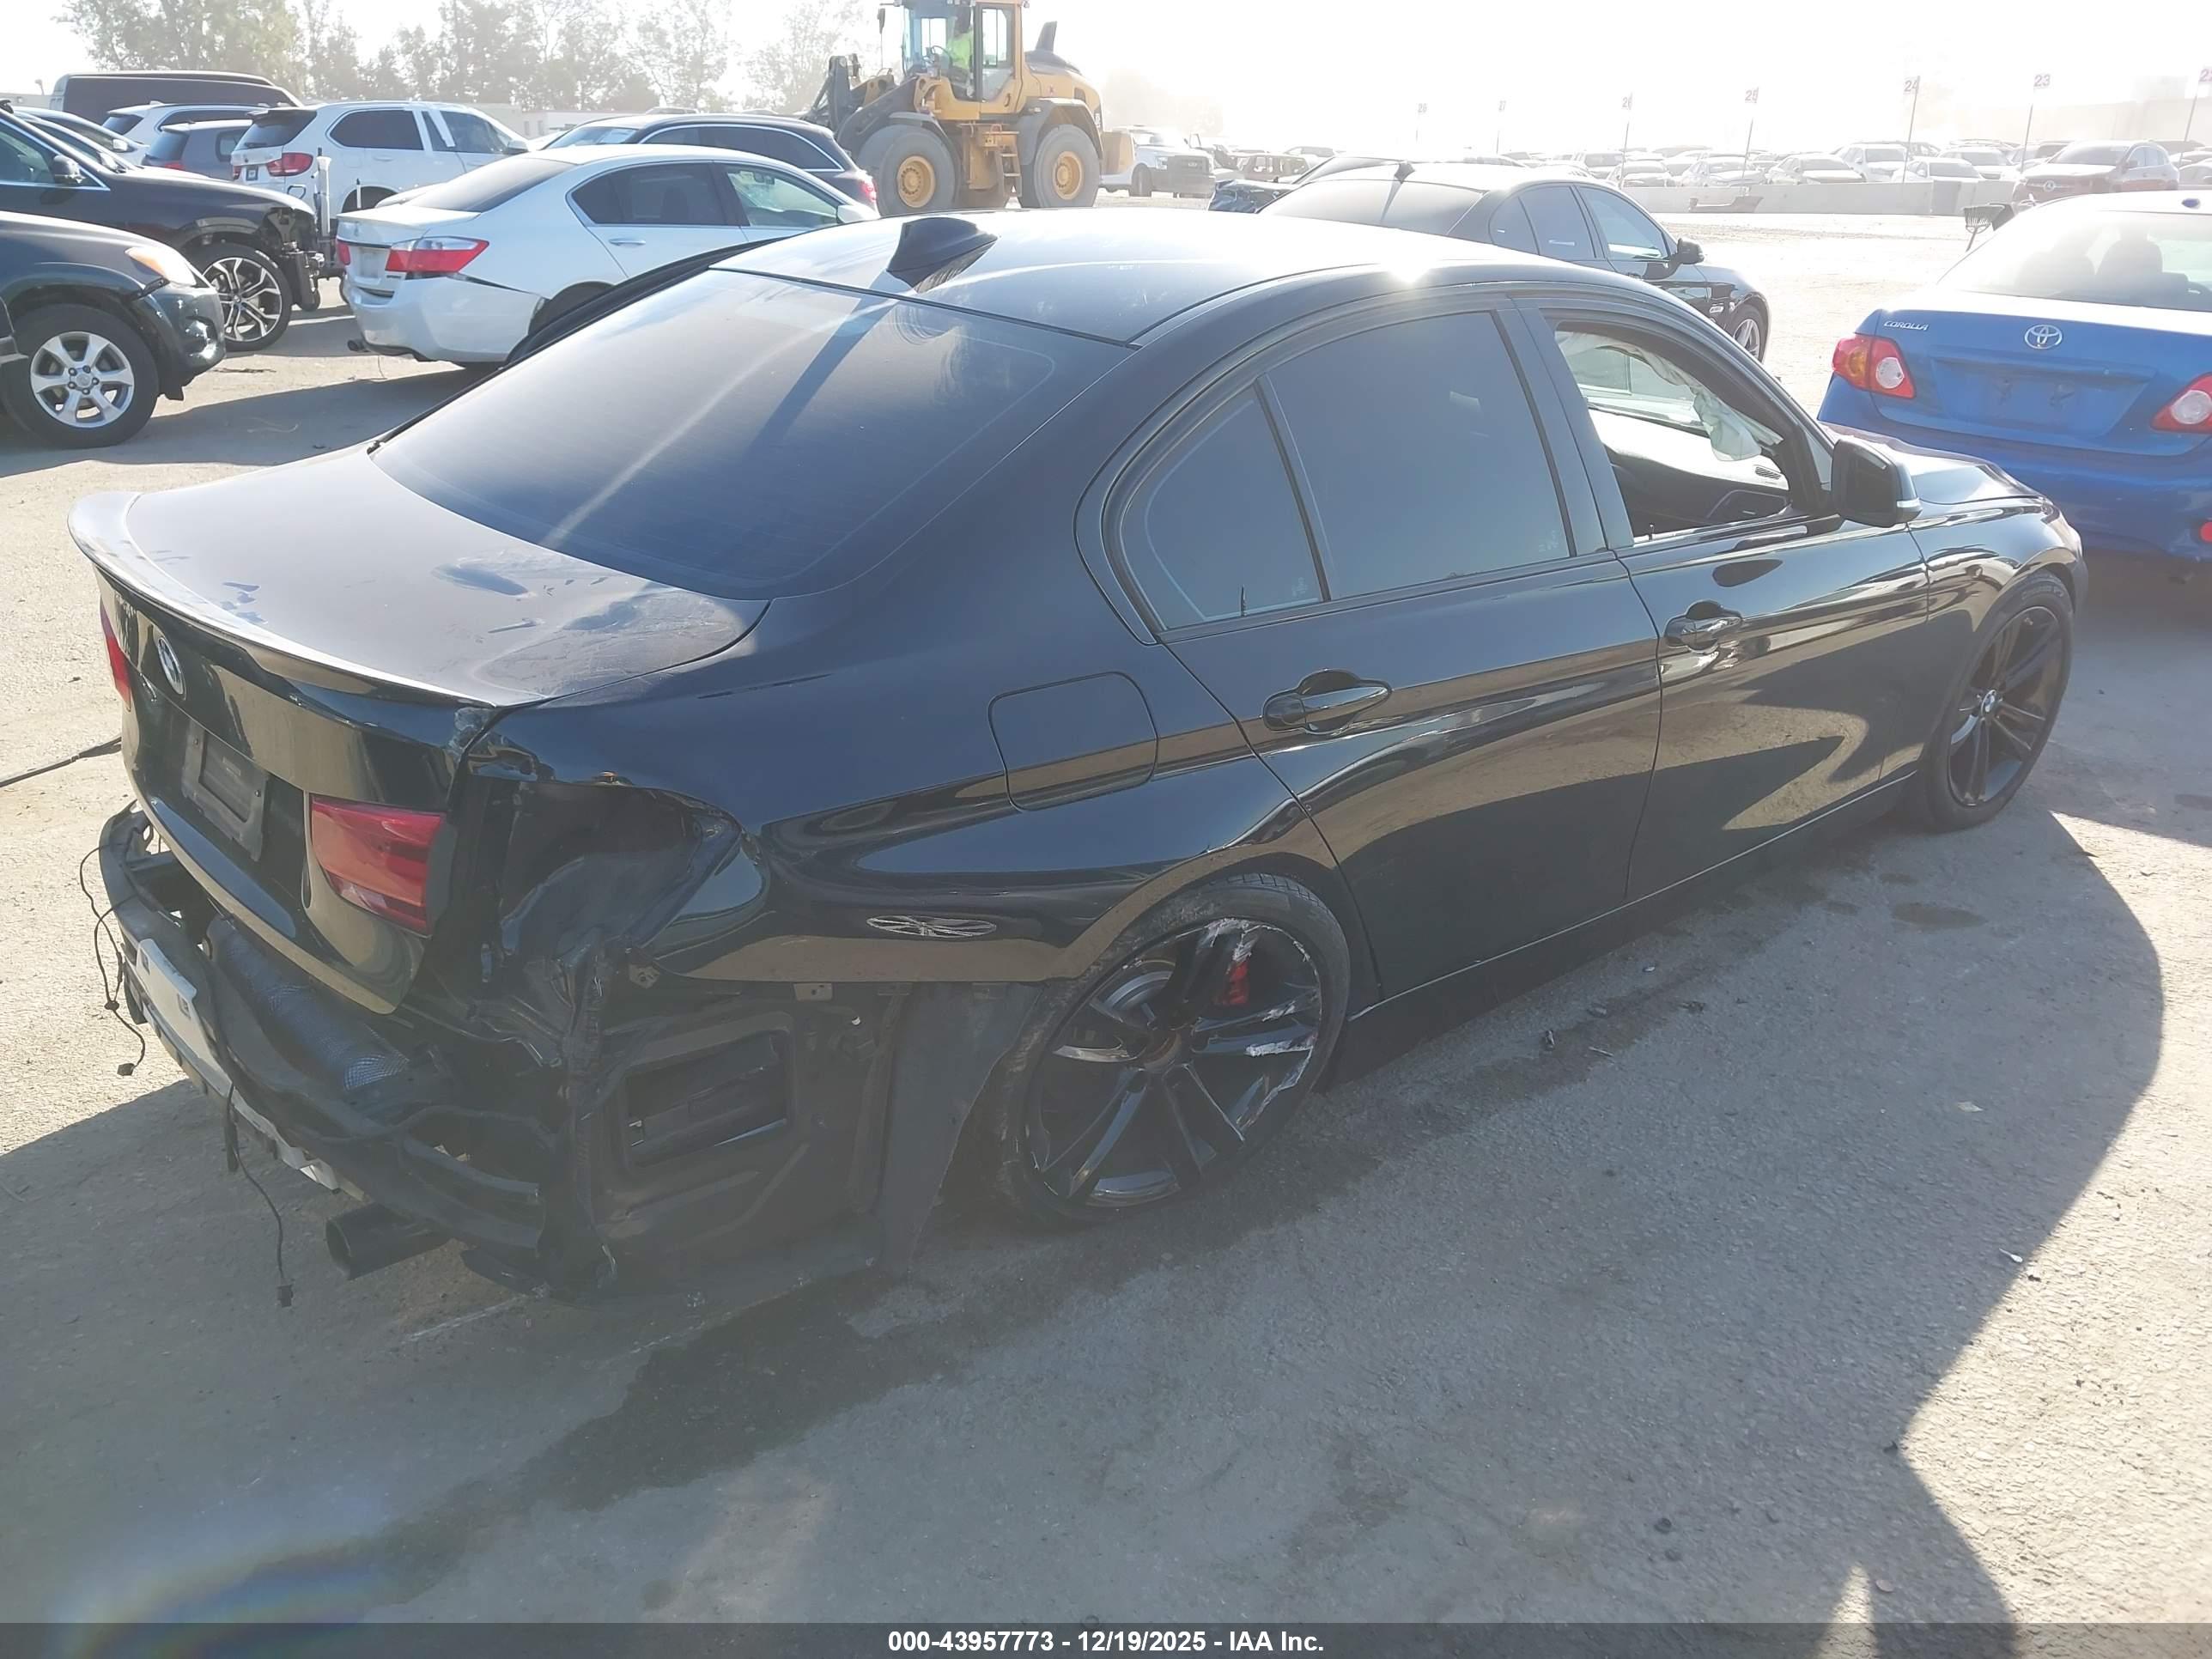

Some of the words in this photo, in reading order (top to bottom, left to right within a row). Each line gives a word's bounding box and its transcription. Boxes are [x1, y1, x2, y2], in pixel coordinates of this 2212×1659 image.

[1904, 80, 1918, 92] 24
[2033, 74, 2050, 88] 23
[1883, 321, 1929, 331] COROLLA
